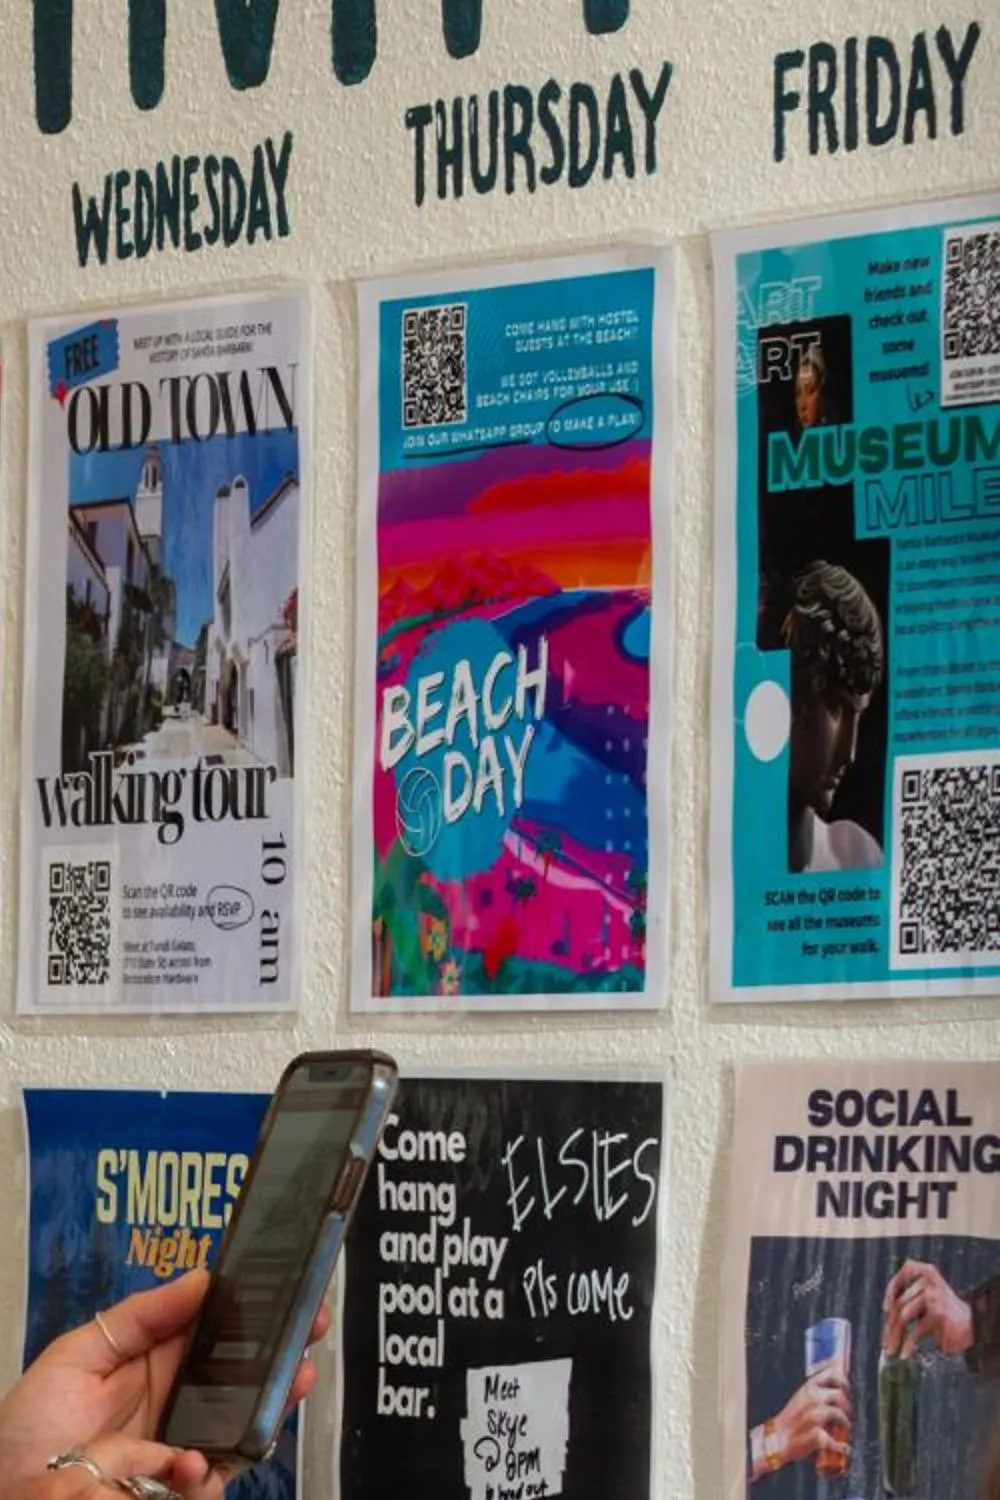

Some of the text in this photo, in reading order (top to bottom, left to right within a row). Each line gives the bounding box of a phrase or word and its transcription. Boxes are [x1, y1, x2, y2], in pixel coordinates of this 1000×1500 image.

[773, 22, 980, 162] FRIDAY
[406, 62, 673, 205] THURSDAY
[72, 132, 293, 268] WEDNESDAY
[133, 336, 152, 350] MEET
[504, 309, 639, 337] COME HANG WITH HOSTEL
[514, 336, 553, 353] GUESTS
[556, 333, 570, 348] AT
[573, 330, 593, 346] THE
[63, 334, 100, 380] FREE
[501, 373, 517, 389] WE
[519, 370, 539, 387] GOT
[616, 360, 639, 376] AND
[67, 363, 300, 456] OLD TOWN
[476, 392, 510, 409] BEACH
[512, 387, 550, 404] CHAIRS
[553, 384, 575, 399] FOR
[577, 380, 607, 398] YOUR
[403, 435, 426, 449] JOIN
[427, 433, 449, 447] OUR
[451, 427, 506, 445] WHATSAPP
[509, 421, 545, 438] GROUP
[548, 420, 562, 434] TO
[563, 415, 594, 432] MAKE
[597, 416, 604, 428] A
[768, 416, 1000, 491] MUSEUM
[380, 631, 549, 773] BEACH
[189, 762, 277, 823] tour
[442, 725, 535, 824] DAY
[807, 1088, 973, 1128] SOCIAL
[378, 1114, 467, 1163] Come
[773, 1134, 1000, 1174] DRINKING
[96, 1149, 250, 1229] S'MORES
[378, 1163, 458, 1227] hang
[816, 1180, 958, 1219] NIGHT
[127, 1225, 212, 1278] Night
[380, 1217, 508, 1280] and play
[379, 1267, 505, 1325] pool at a
[379, 1317, 445, 1368] local
[377, 1366, 436, 1419] bar.
